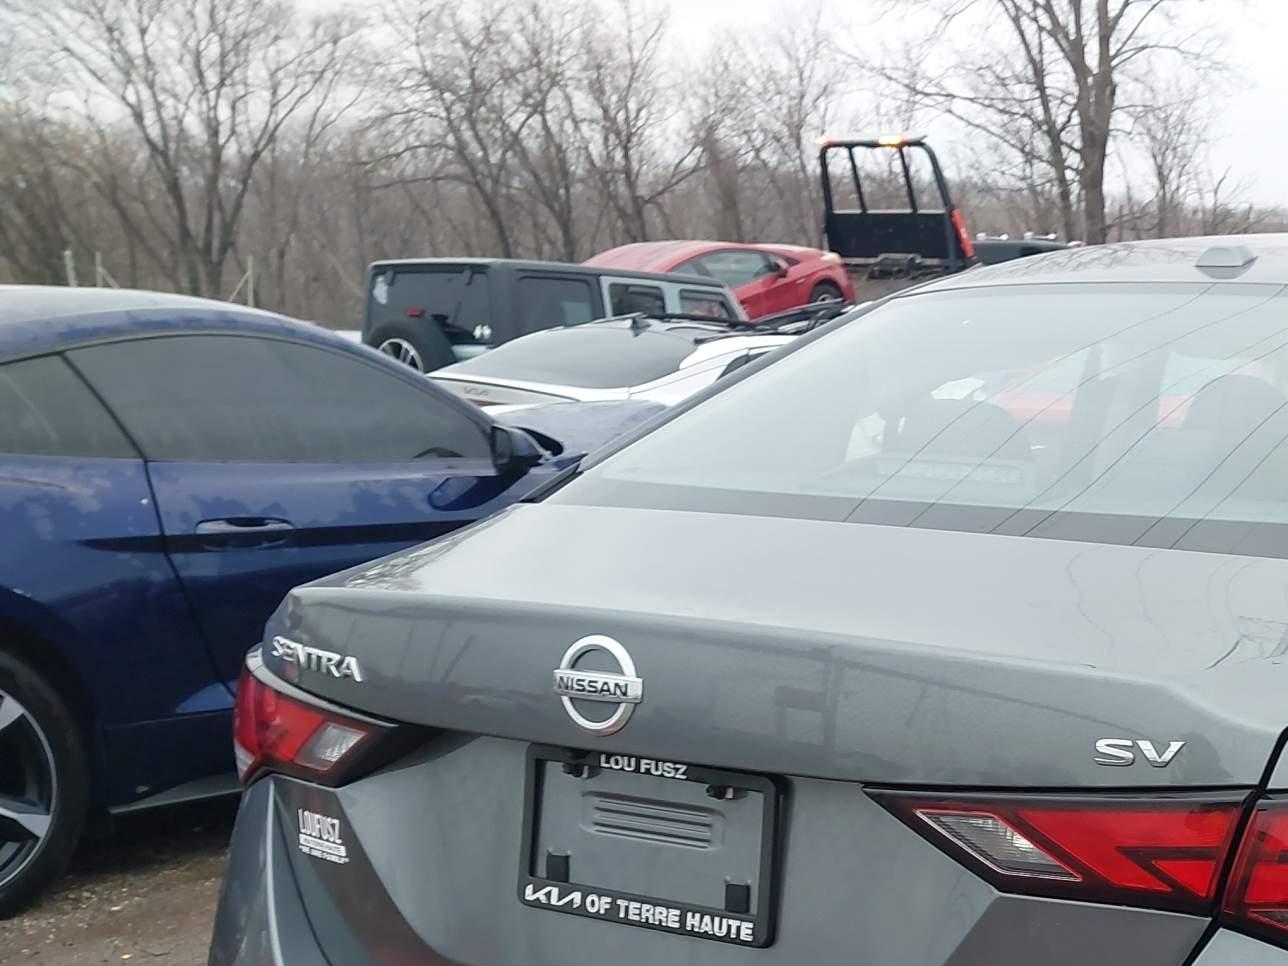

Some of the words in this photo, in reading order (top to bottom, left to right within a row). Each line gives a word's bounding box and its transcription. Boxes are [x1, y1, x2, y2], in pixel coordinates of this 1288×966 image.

[272, 635, 363, 682] SENTRA
[559, 675, 629, 697] NISSAN
[600, 754, 636, 771] LOU
[640, 759, 688, 779] FUSZ
[1094, 738, 1186, 768] SV
[524, 884, 582, 908] KIA
[585, 894, 612, 914] OF
[616, 899, 681, 928] TERRE
[686, 911, 754, 941] HAUTE
